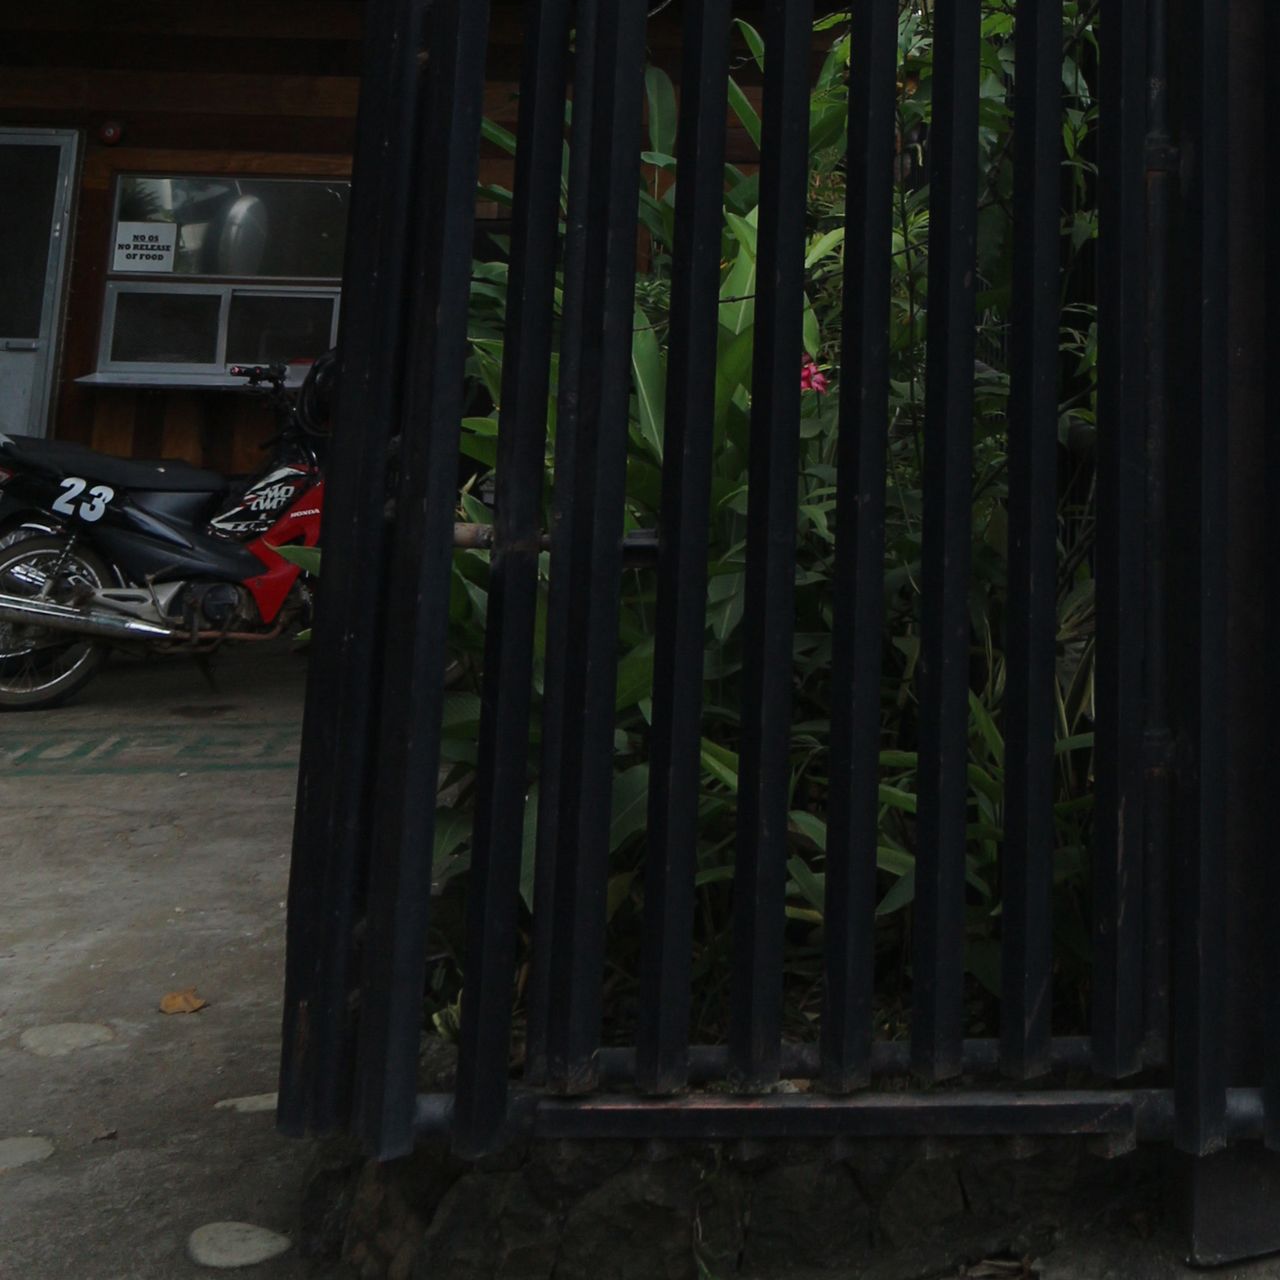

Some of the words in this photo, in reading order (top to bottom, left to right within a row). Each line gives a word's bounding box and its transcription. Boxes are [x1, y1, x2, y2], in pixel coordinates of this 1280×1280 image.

[132, 244, 171, 252] RELEASE
[140, 253, 164, 261] FOOD
[52, 476, 114, 522] 23
[290, 508, 321, 518] HONDA
